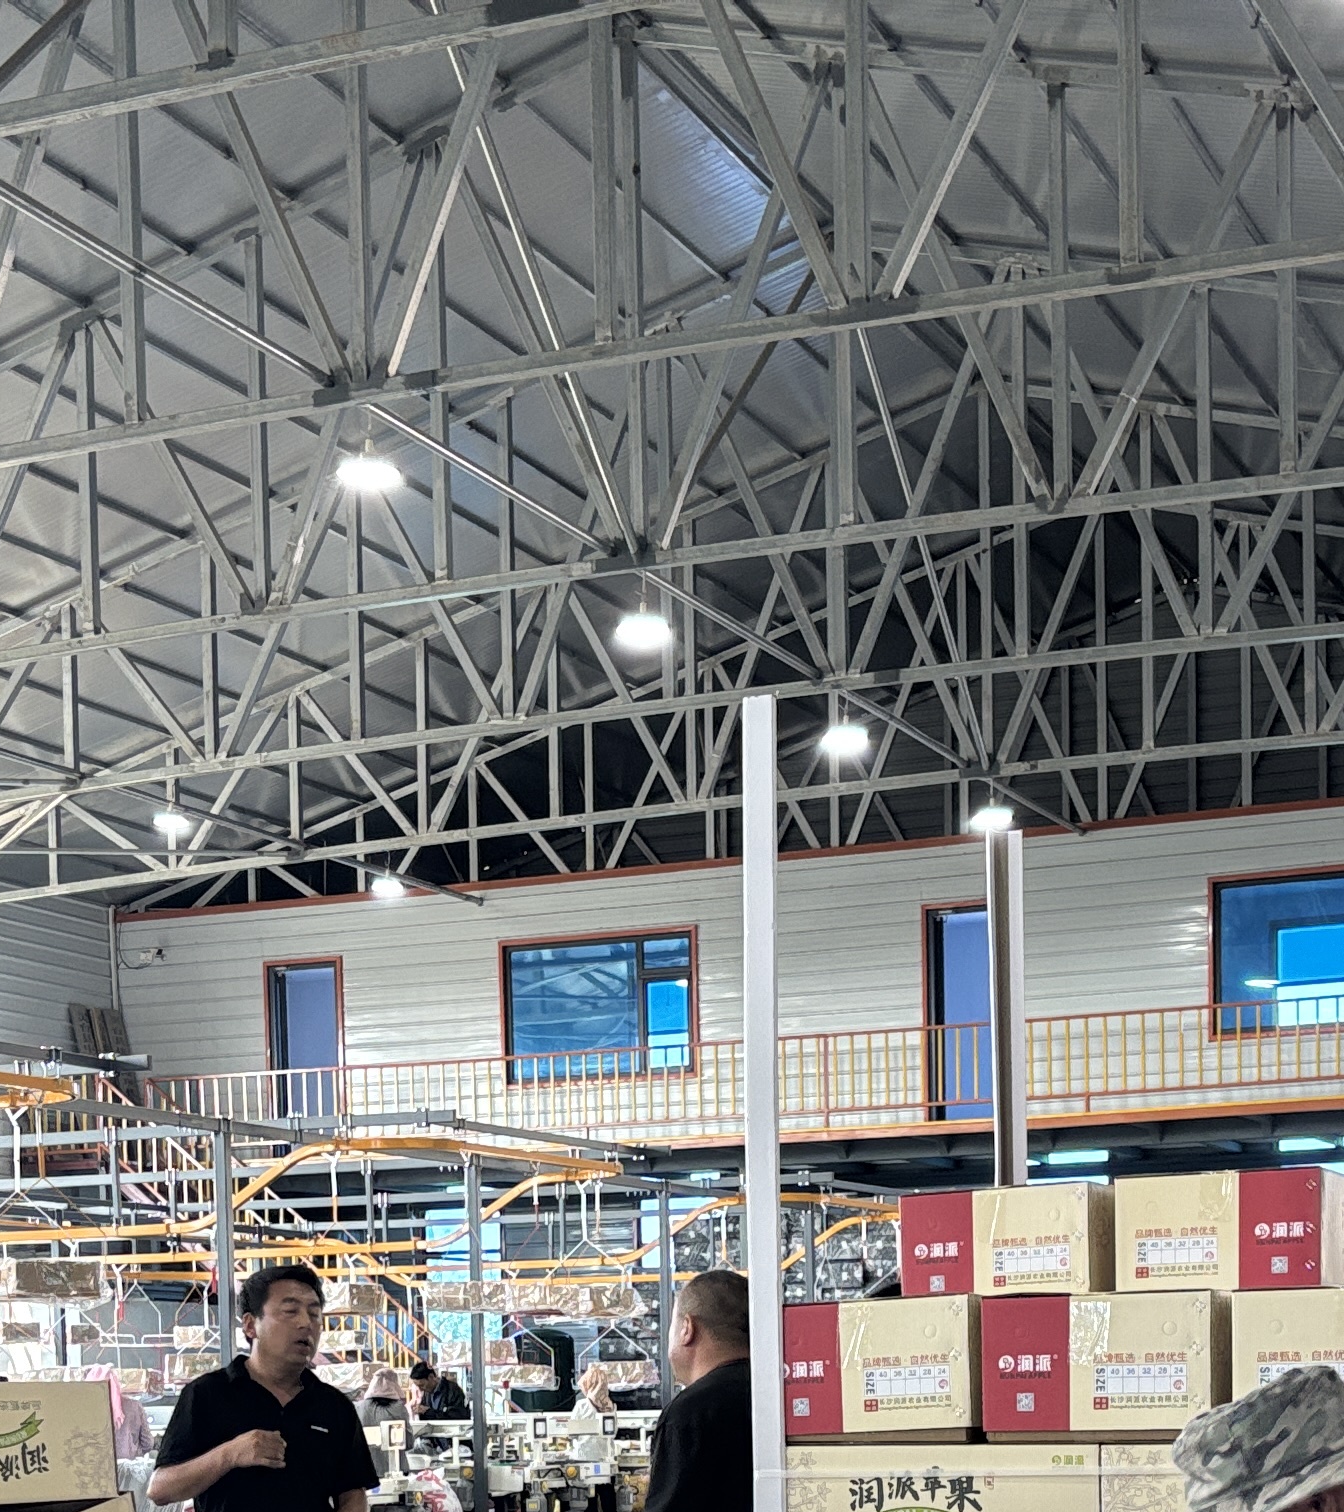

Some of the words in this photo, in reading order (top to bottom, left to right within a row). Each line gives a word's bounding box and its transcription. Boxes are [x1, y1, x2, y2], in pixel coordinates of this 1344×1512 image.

[1272, 1221, 1305, 1238] 润派
[929, 1241, 959, 1258] 润派
[1137, 1240, 1147, 1264] SIZE
[994, 1251, 1004, 1273] SIZE
[792, 1361, 825, 1379] 润派
[1016, 1354, 1052, 1372] 润派
[865, 1370, 876, 1396] SIZE
[1095, 1367, 1106, 1393] SIZE
[848, 1465, 983, 1512] 润派苹果
